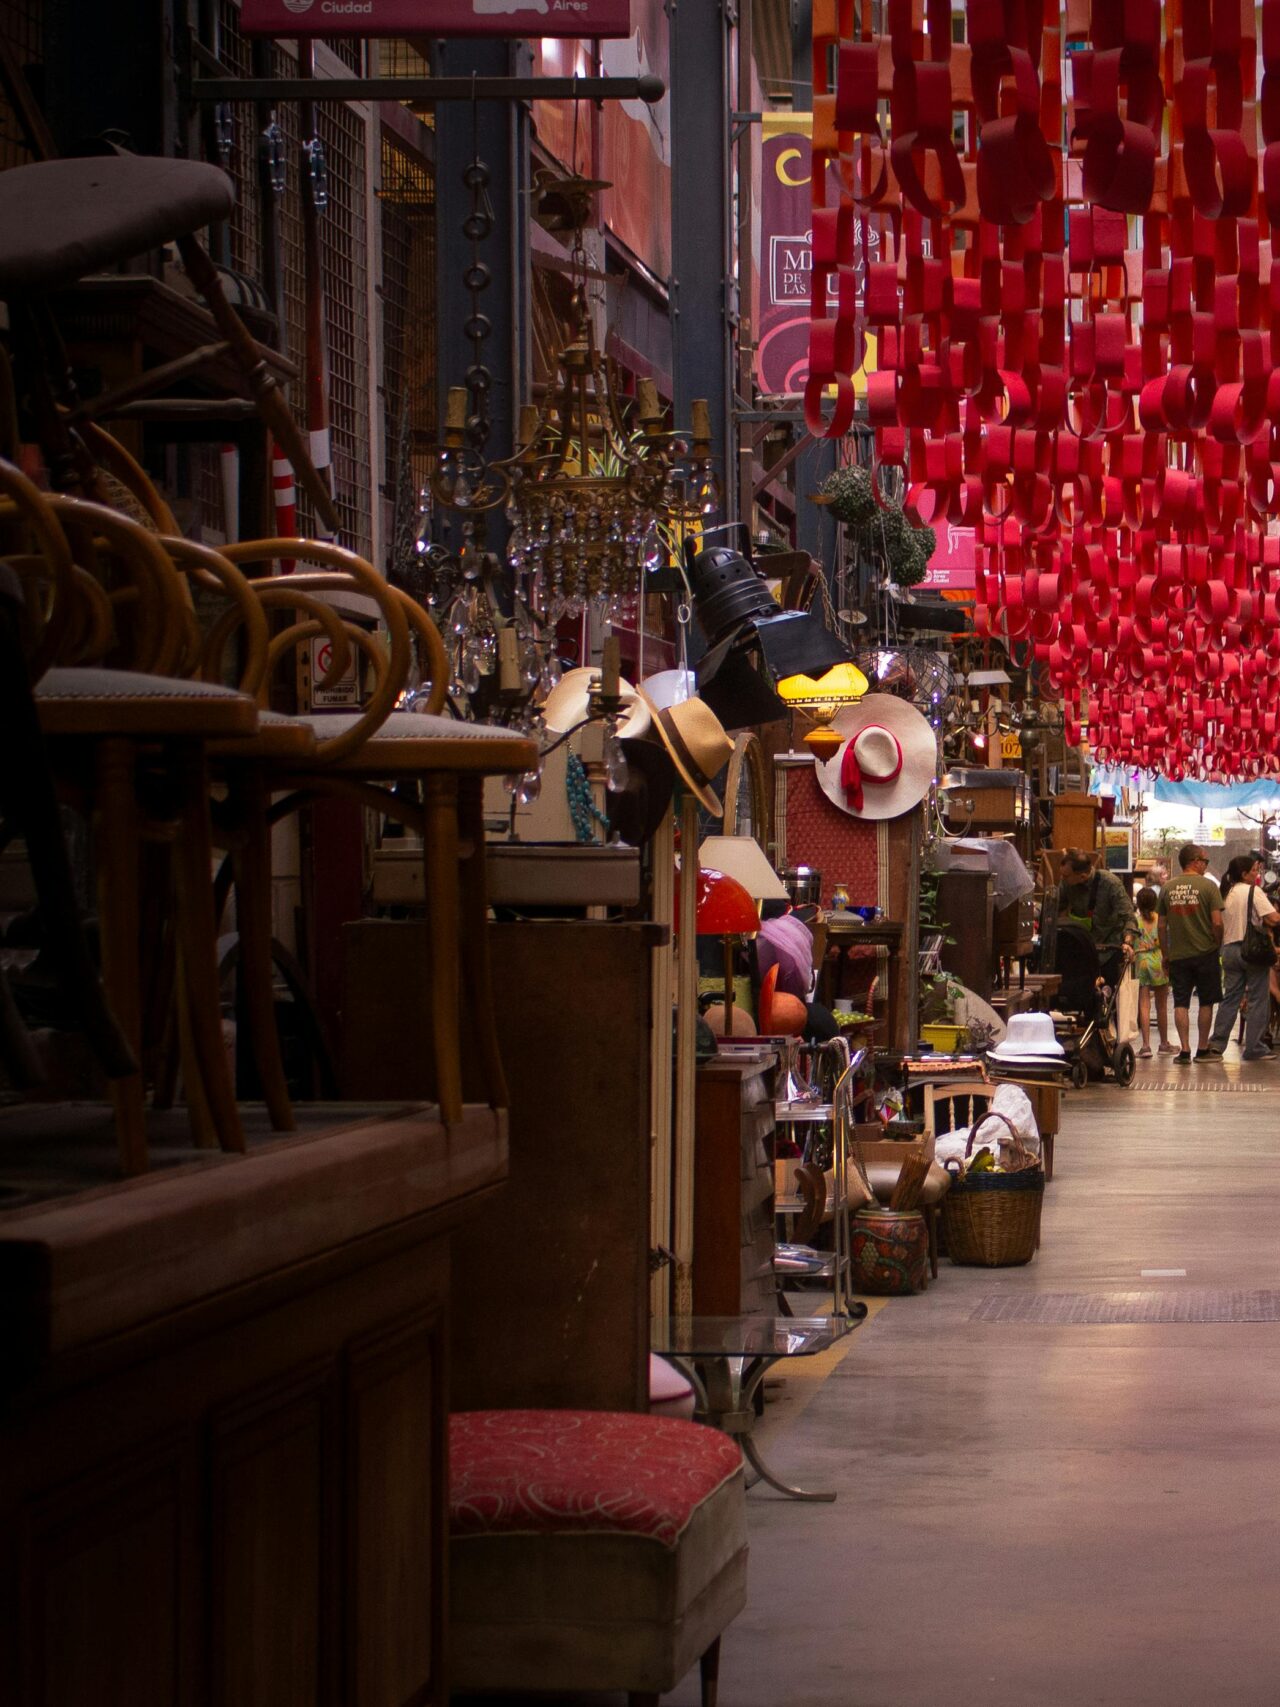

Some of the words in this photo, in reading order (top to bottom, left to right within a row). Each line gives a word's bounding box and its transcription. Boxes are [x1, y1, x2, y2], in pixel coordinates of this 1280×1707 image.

[321, 1, 372, 13] Ciudad
[553, 0, 588, 11] Aires
[783, 273, 802, 283] DE
[783, 284, 806, 294] LAS
[1001, 743, 1020, 754] 107
